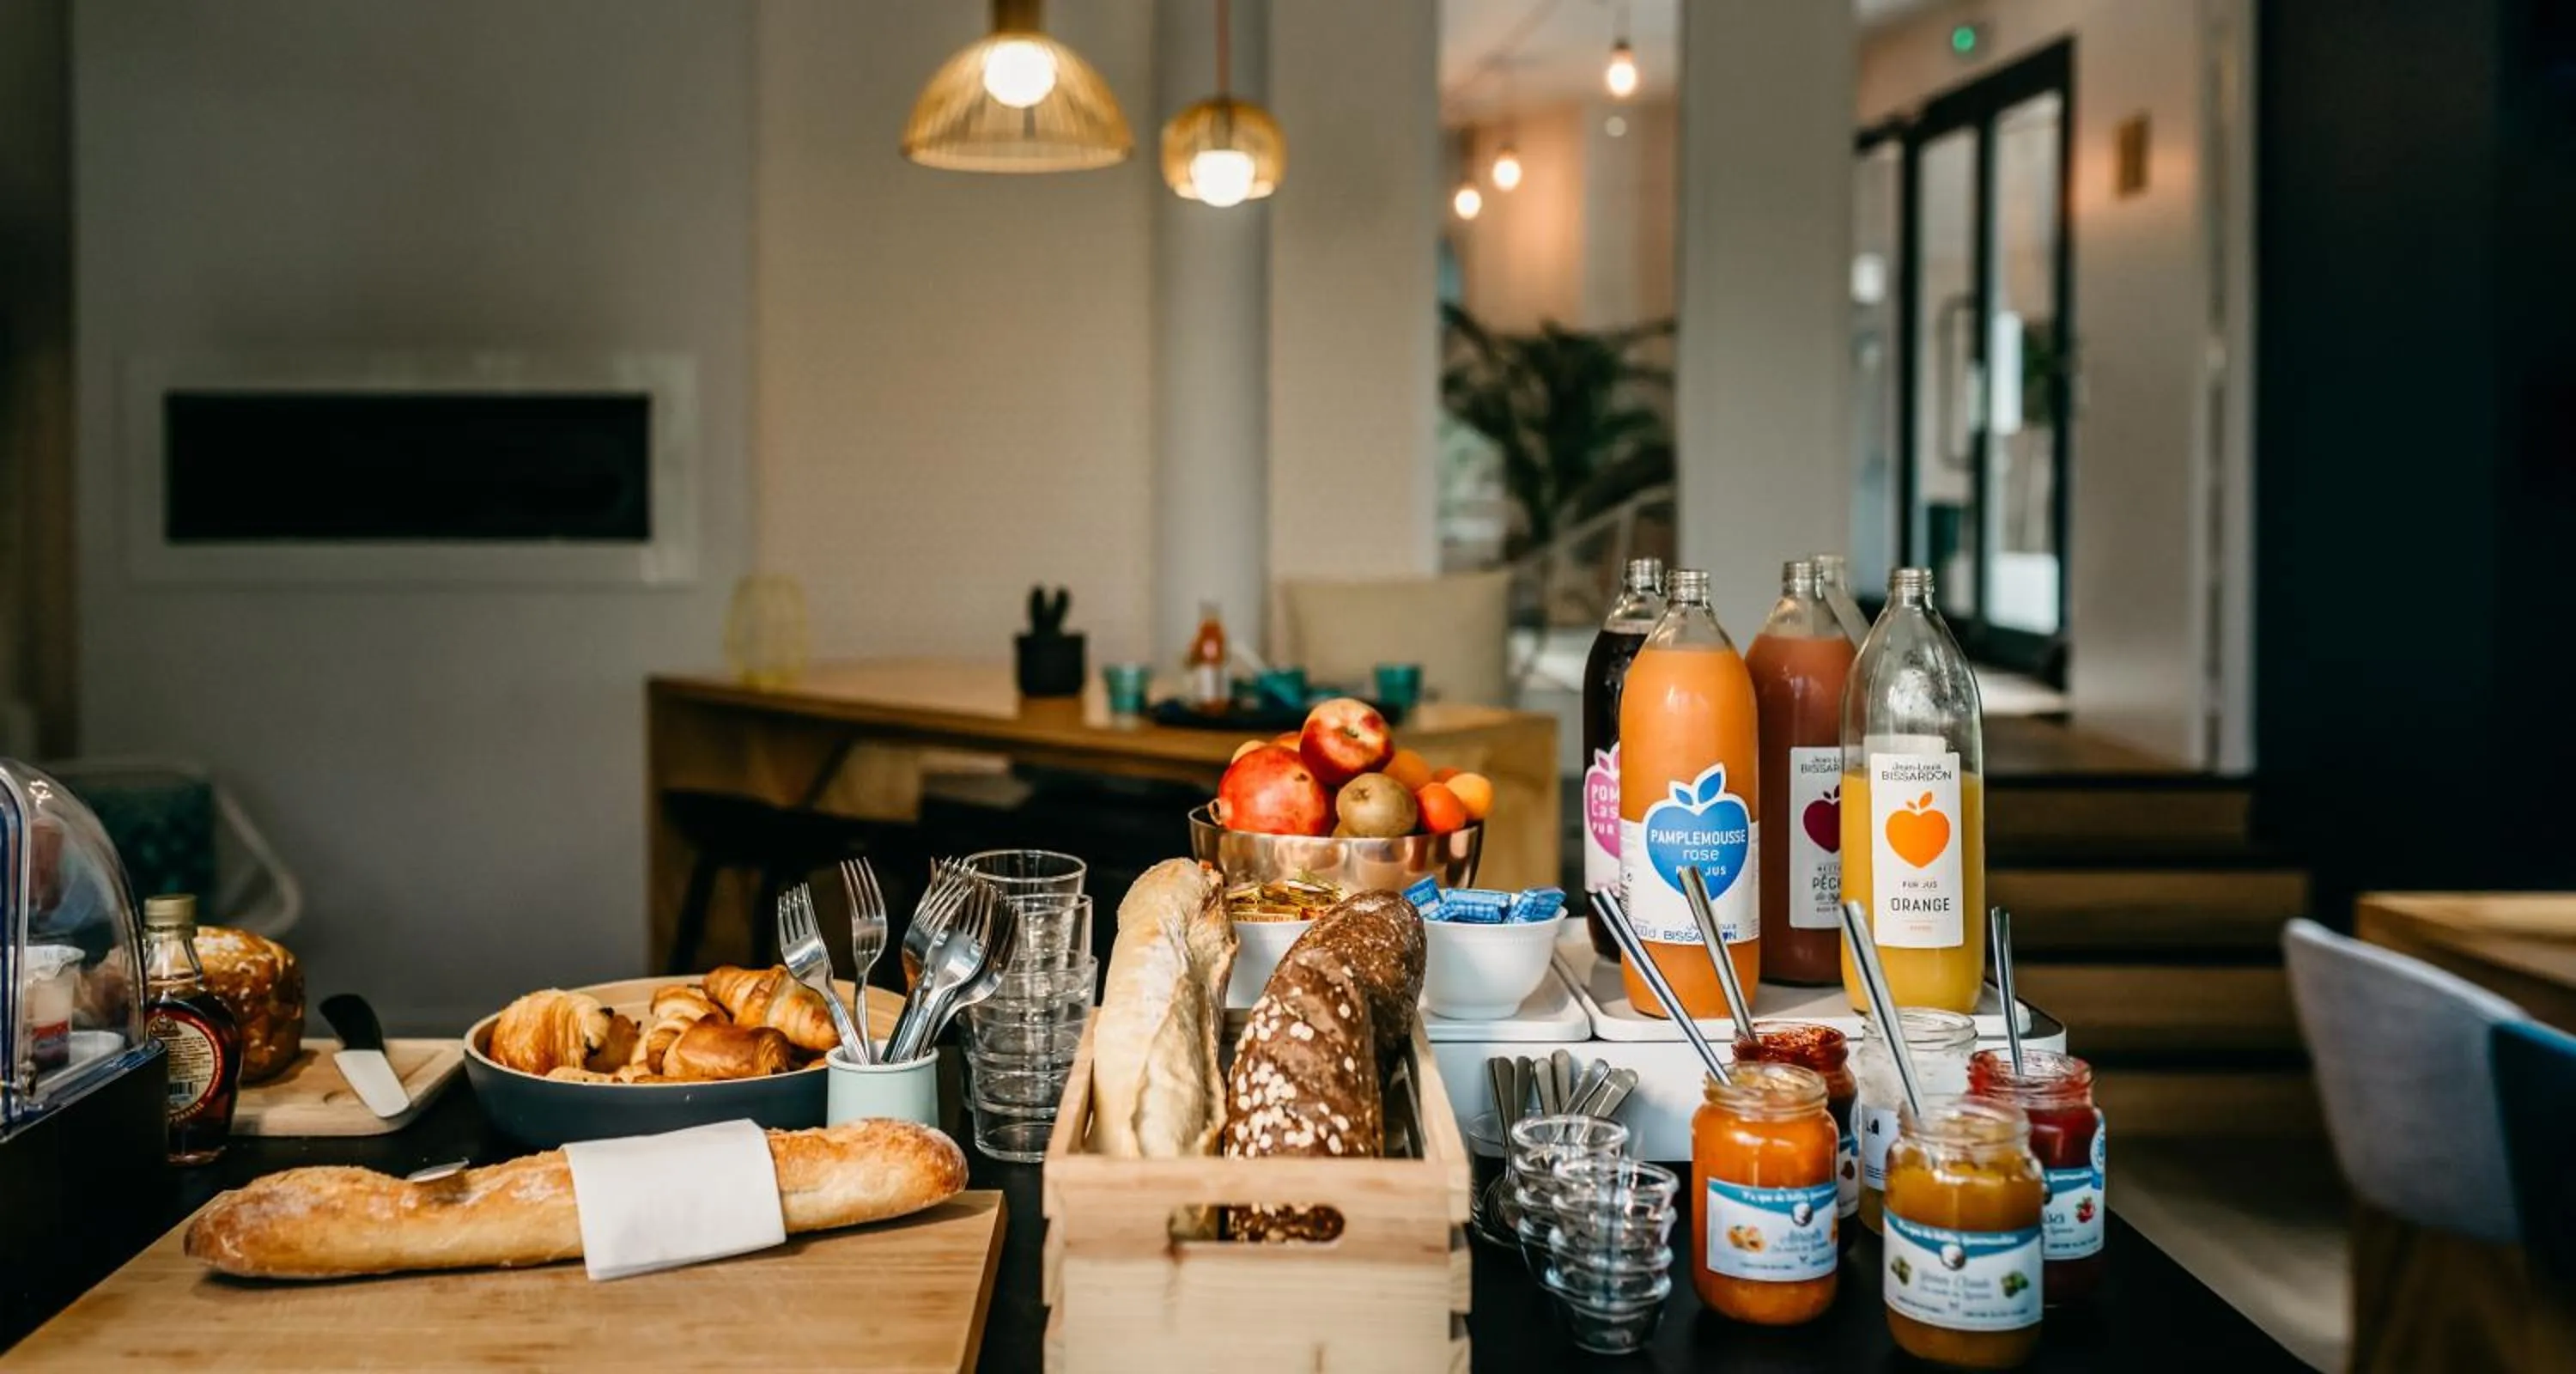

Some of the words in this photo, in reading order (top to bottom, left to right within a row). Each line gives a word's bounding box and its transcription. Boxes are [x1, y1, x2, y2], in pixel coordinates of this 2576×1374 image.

[1801, 763, 1840, 774] BISSAR
[1881, 770, 1952, 781] BISSARDON
[1591, 784, 1619, 803] POM
[1591, 801, 1619, 819] Cas
[1650, 828, 1747, 846] PAMPLEMOUSSE
[1682, 848, 1720, 861] rose
[1704, 865, 1728, 877] JUS
[1921, 880, 1938, 889] JUS
[1890, 897, 1951, 912] ORANGE
